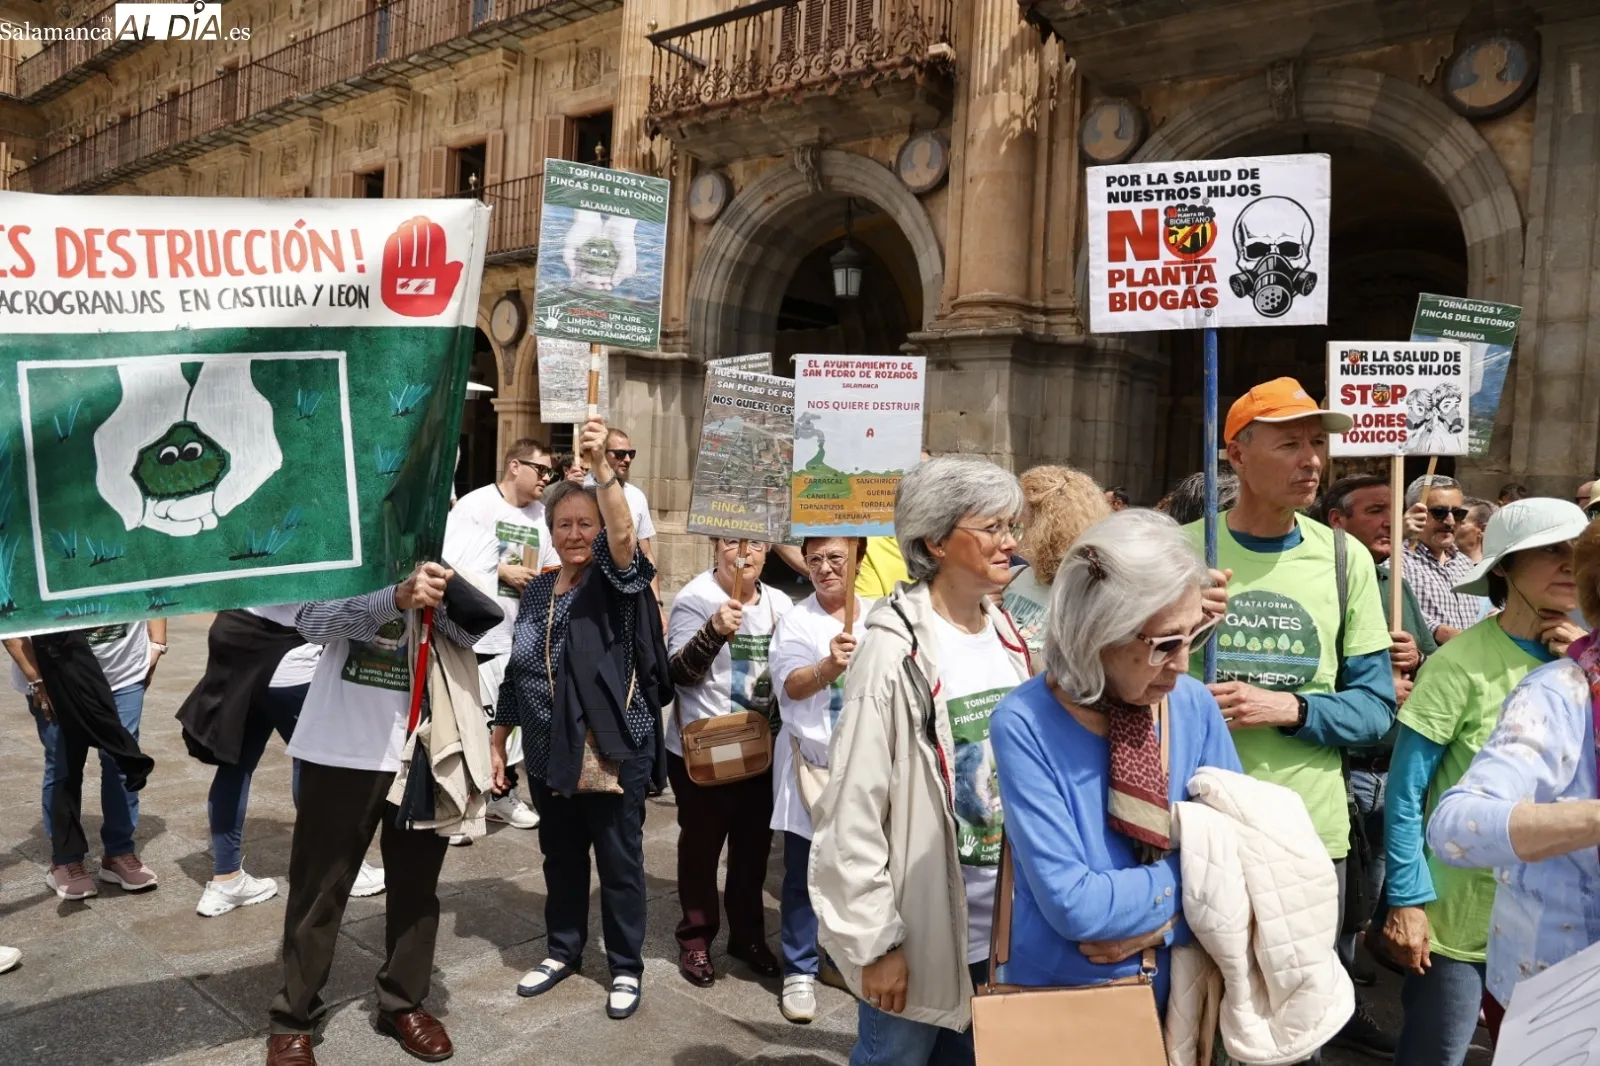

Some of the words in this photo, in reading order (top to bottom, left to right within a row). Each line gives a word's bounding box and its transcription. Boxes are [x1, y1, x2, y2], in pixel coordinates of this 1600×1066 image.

[568, 166, 637, 187] TORNADIZOS
[639, 179, 646, 188] Y
[1105, 174, 1142, 188] POR
[1146, 172, 1169, 185] LA
[1173, 169, 1232, 184] SALUD
[1237, 168, 1261, 180] DE
[550, 175, 589, 191] FINCAS
[591, 183, 611, 195] DEL
[613, 188, 664, 204] ENTORNO
[1106, 187, 1201, 204] NUESTROS
[1206, 184, 1262, 199] HIJOS
[579, 199, 631, 216] SALAMANCA
[1170, 216, 1211, 225] BIOMETANO
[1107, 264, 1218, 289] PLANTA
[179, 288, 212, 313] EN
[217, 284, 307, 310] CASTILLA
[311, 284, 324, 307] Y
[329, 284, 370, 310] LEON
[1108, 286, 1219, 313] BIOGÁS
[1438, 299, 1495, 314] TORNADIZOS
[1495, 306, 1503, 315] Y
[608, 312, 621, 322] UN
[622, 314, 641, 324] AIRE
[1420, 309, 1453, 320] FINCAS
[1454, 314, 1472, 323] DEL
[1473, 316, 1516, 329] ENTORNO
[566, 326, 580, 334] SIN
[581, 327, 651, 343] CONTAMINACIÓN
[599, 321, 613, 332] SIN
[614, 323, 647, 334] OLORES
[648, 327, 654, 335] Y
[1442, 329, 1485, 341] SALAMANCA
[1372, 351, 1389, 362] LA
[1393, 350, 1439, 363] SALUD
[1443, 351, 1461, 362] DE
[807, 359, 820, 368] EL
[823, 360, 898, 370] AYUNTAMIENTO
[900, 362, 913, 370] DE
[1340, 364, 1415, 376] NUESTROS
[1418, 364, 1461, 376] HIJOS
[714, 367, 755, 381] NUESTRO
[802, 369, 822, 377] SAN
[825, 369, 856, 378] PEDRO
[859, 370, 872, 378] DE
[874, 370, 918, 380] ROZADOS
[717, 380, 735, 390] SAN
[737, 383, 765, 395] PEDRO
[768, 388, 779, 398] DE
[1340, 383, 1408, 406] STOP
[712, 394, 733, 406] NOS
[735, 399, 770, 412] QUIERE
[807, 400, 830, 409] NOS
[832, 400, 869, 411] QUIERE
[872, 401, 920, 411] DESTRUIR
[1352, 413, 1407, 428] LORES
[866, 428, 875, 438] A
[1341, 427, 1407, 444] TÓXICOS
[711, 501, 746, 514] FINCA
[800, 503, 845, 511] TORNADIZOS
[691, 513, 766, 533] TORNADIZOS
[1234, 600, 1295, 610] PLATAFORMA
[1225, 613, 1302, 631] GAJATES
[384, 671, 394, 679] SIN
[1216, 669, 1239, 681] SIN
[1248, 671, 1305, 686] MIERDA
[954, 712, 984, 726] FINCAS
[980, 853, 994, 863] SIN
